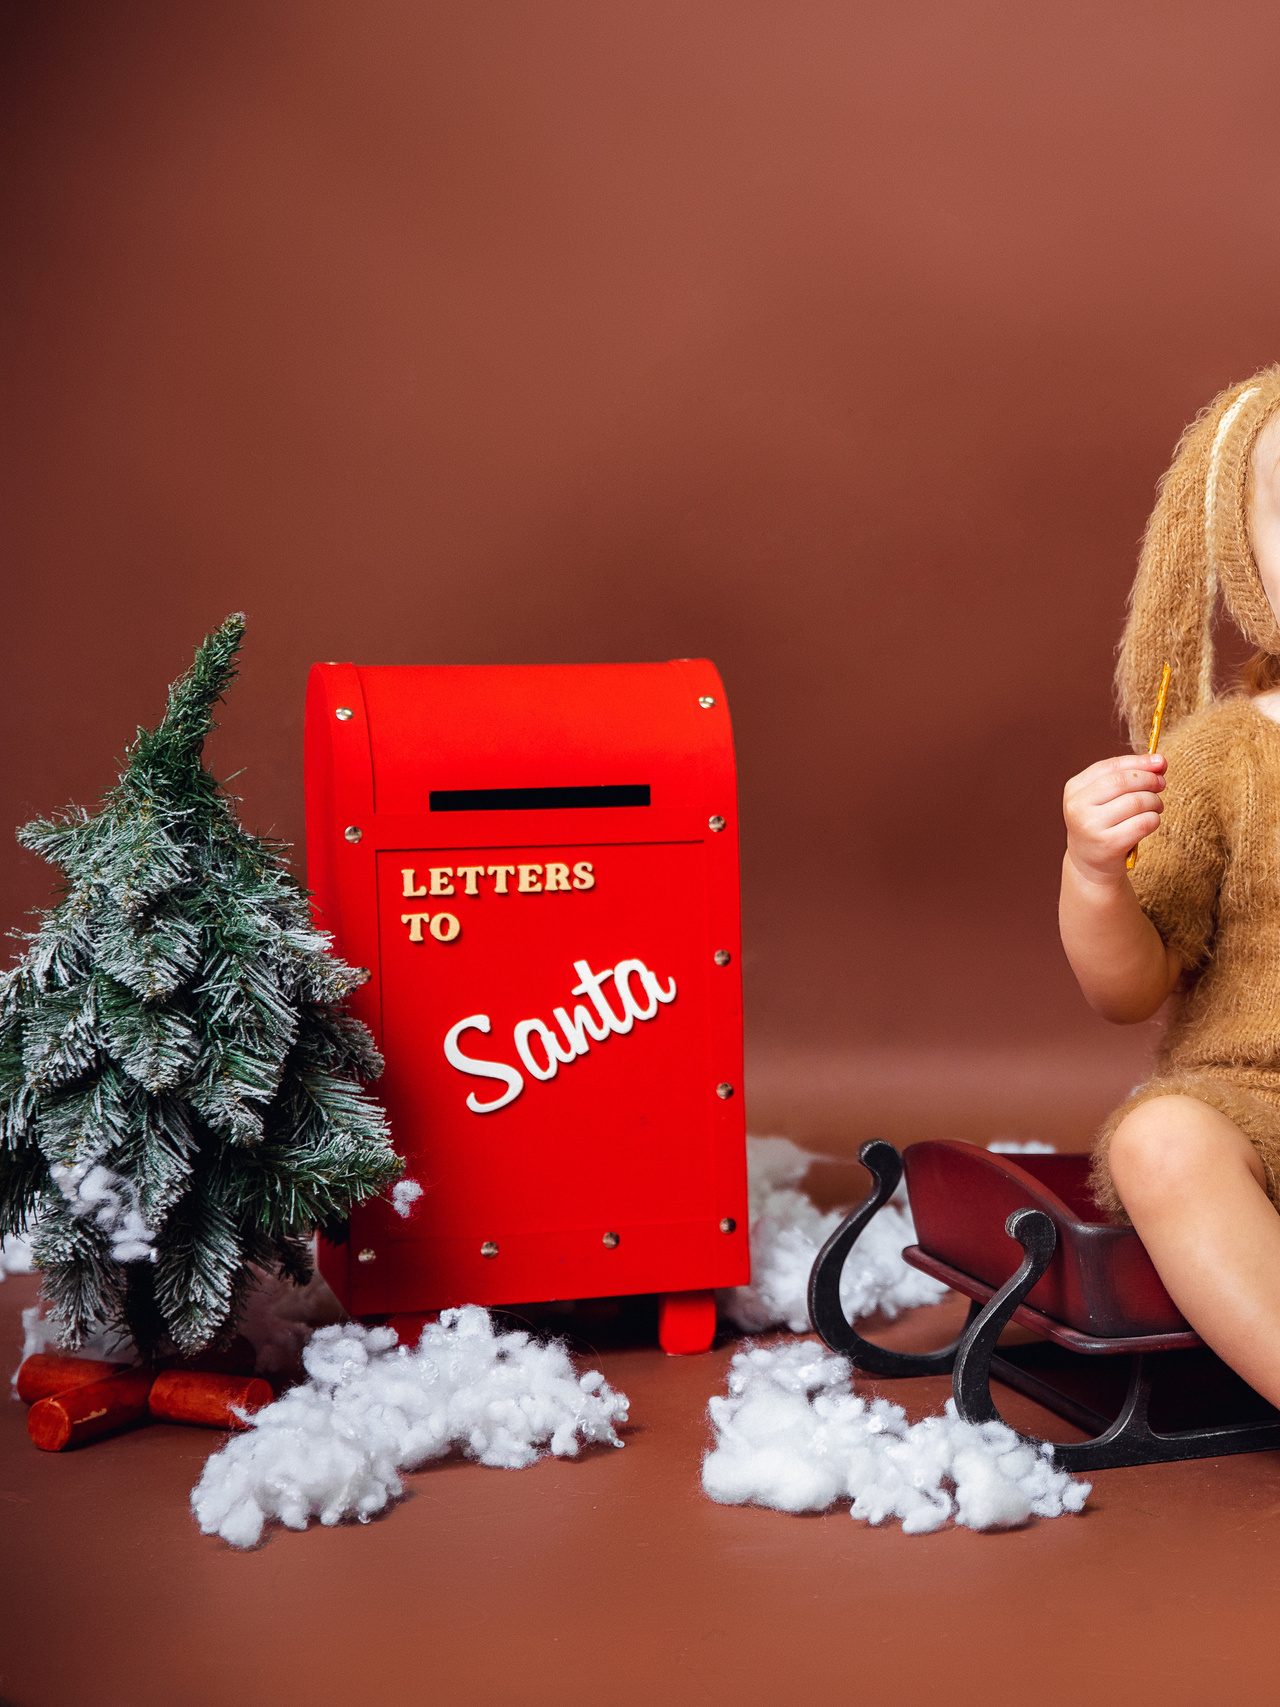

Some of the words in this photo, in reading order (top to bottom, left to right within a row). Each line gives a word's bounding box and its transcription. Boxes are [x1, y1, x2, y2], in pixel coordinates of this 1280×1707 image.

[400, 861, 596, 897] LETTERS
[400, 912, 461, 942] TO
[443, 958, 678, 1114] Santa
